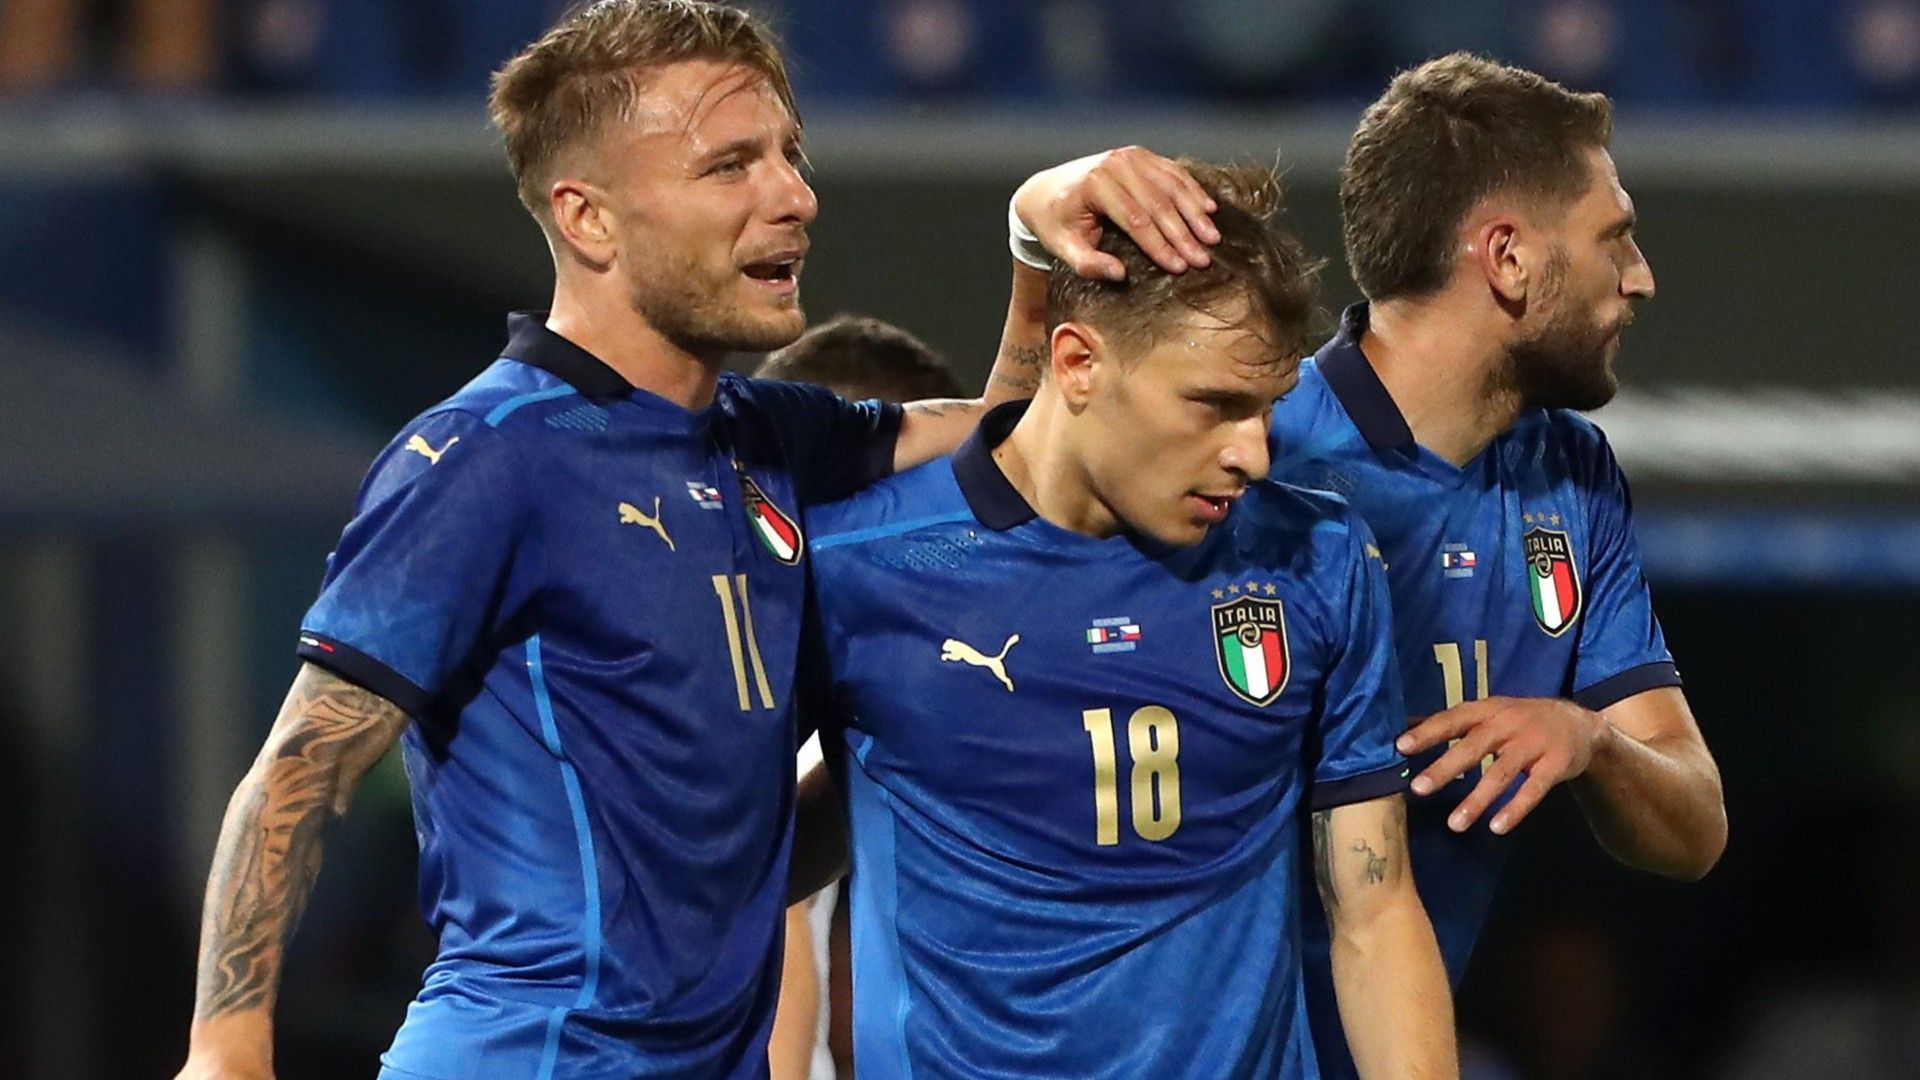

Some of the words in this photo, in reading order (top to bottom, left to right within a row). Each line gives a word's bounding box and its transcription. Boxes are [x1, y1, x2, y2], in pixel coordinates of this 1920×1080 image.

[711, 573, 775, 711] 11
[1218, 606, 1276, 627] ITALIA
[1082, 704, 1182, 846] 18
